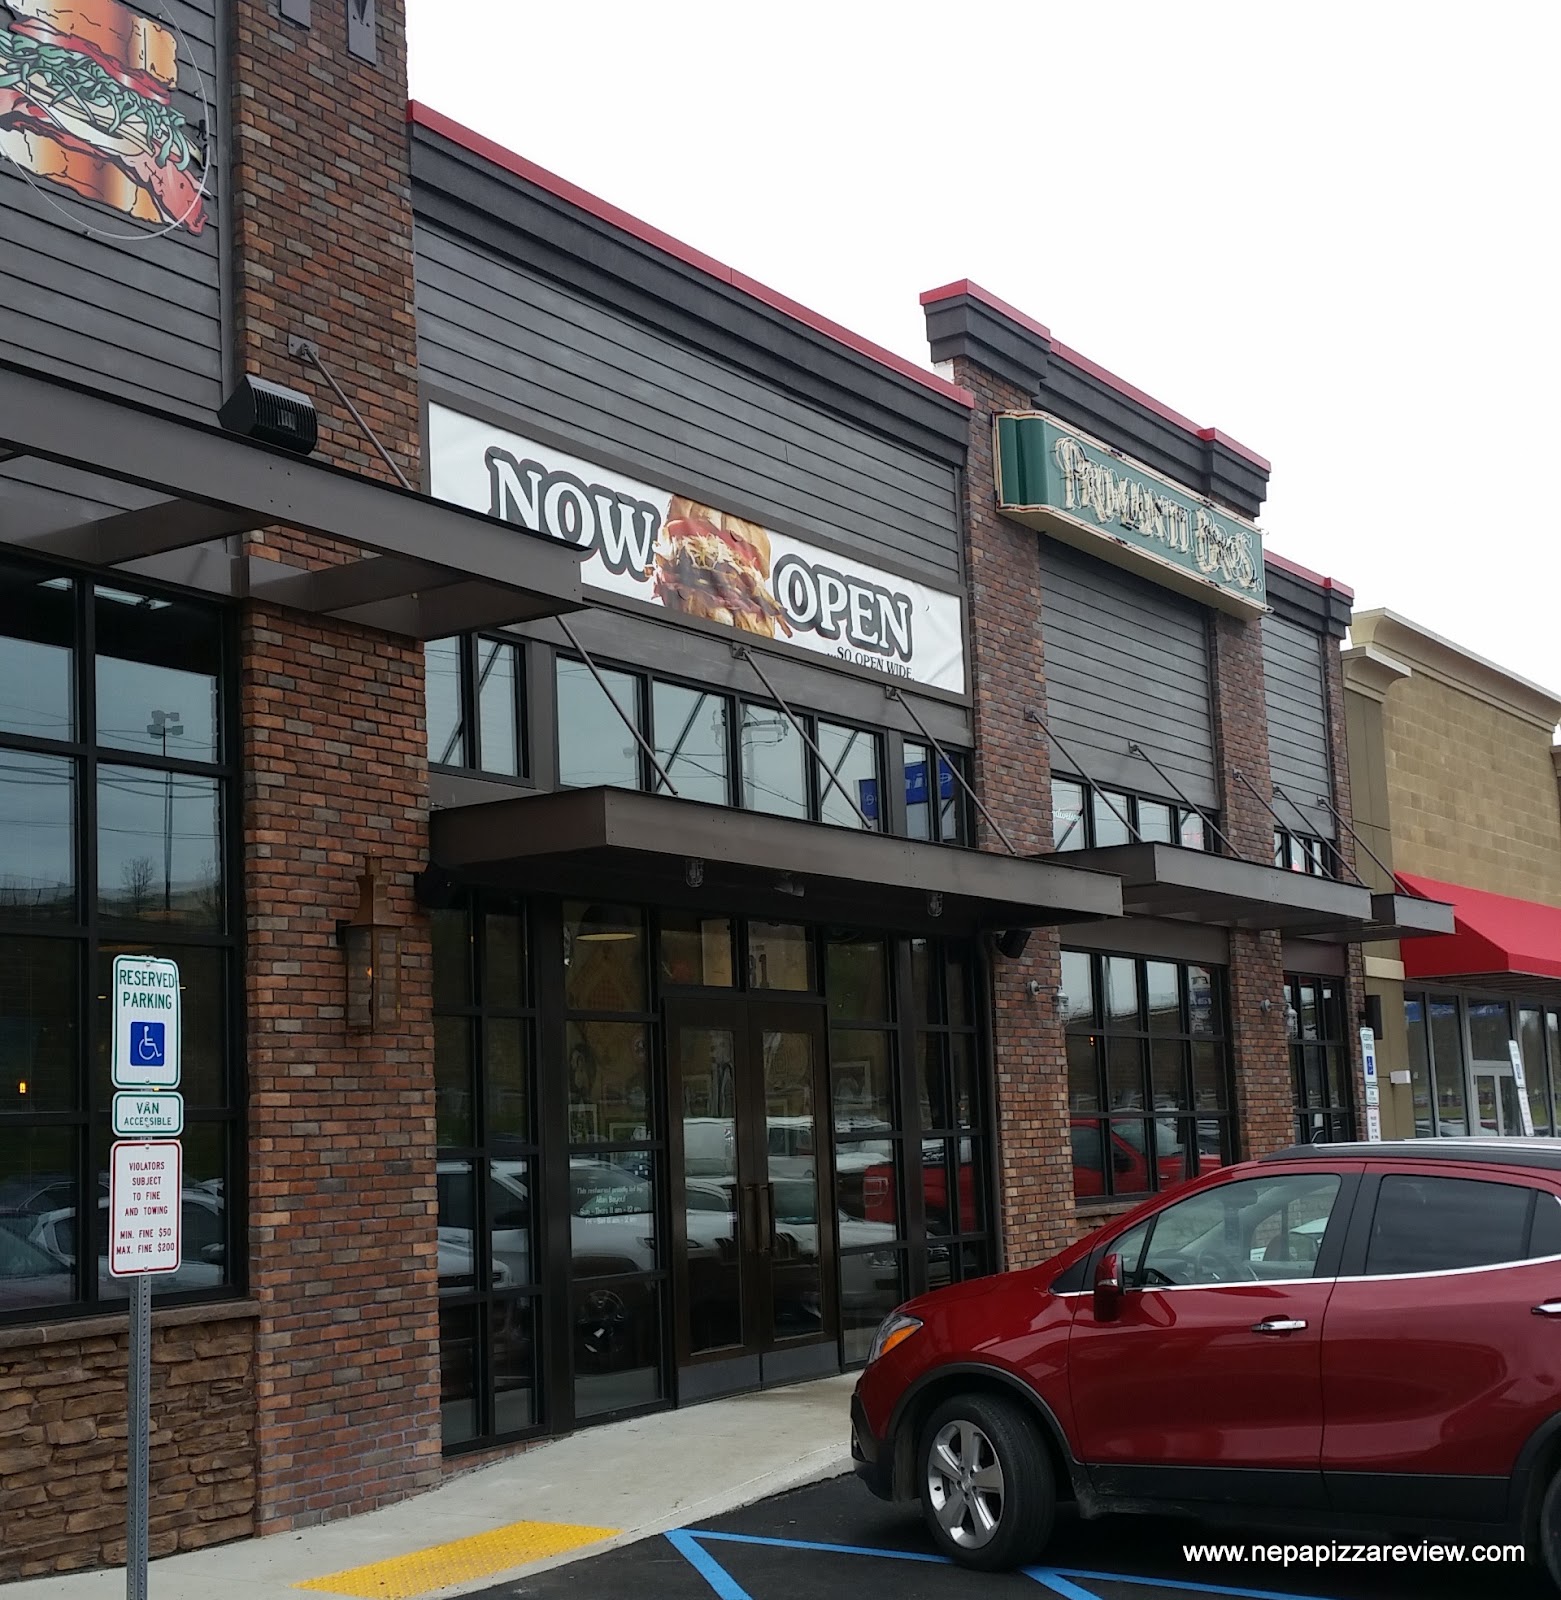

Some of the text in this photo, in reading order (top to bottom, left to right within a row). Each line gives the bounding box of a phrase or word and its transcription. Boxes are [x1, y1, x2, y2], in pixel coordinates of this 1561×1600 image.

[485, 446, 914, 662] NOW OPEN
[855, 652, 884, 672] OPEN
[119, 969, 175, 988] RESERVED
[123, 991, 172, 1010] PARKING
[136, 1102, 160, 1115] VAN
[123, 1116, 172, 1127] ACCESSIBLE
[129, 1161, 165, 1171] VIOLATORS
[132, 1176, 162, 1186] SUBJECT
[133, 1191, 161, 1201] TO FINE
[125, 1205, 169, 1217] AND TOWING
[120, 1227, 172, 1240] MIN. FINE $50
[116, 1242, 175, 1255] MAX. FINE $200
